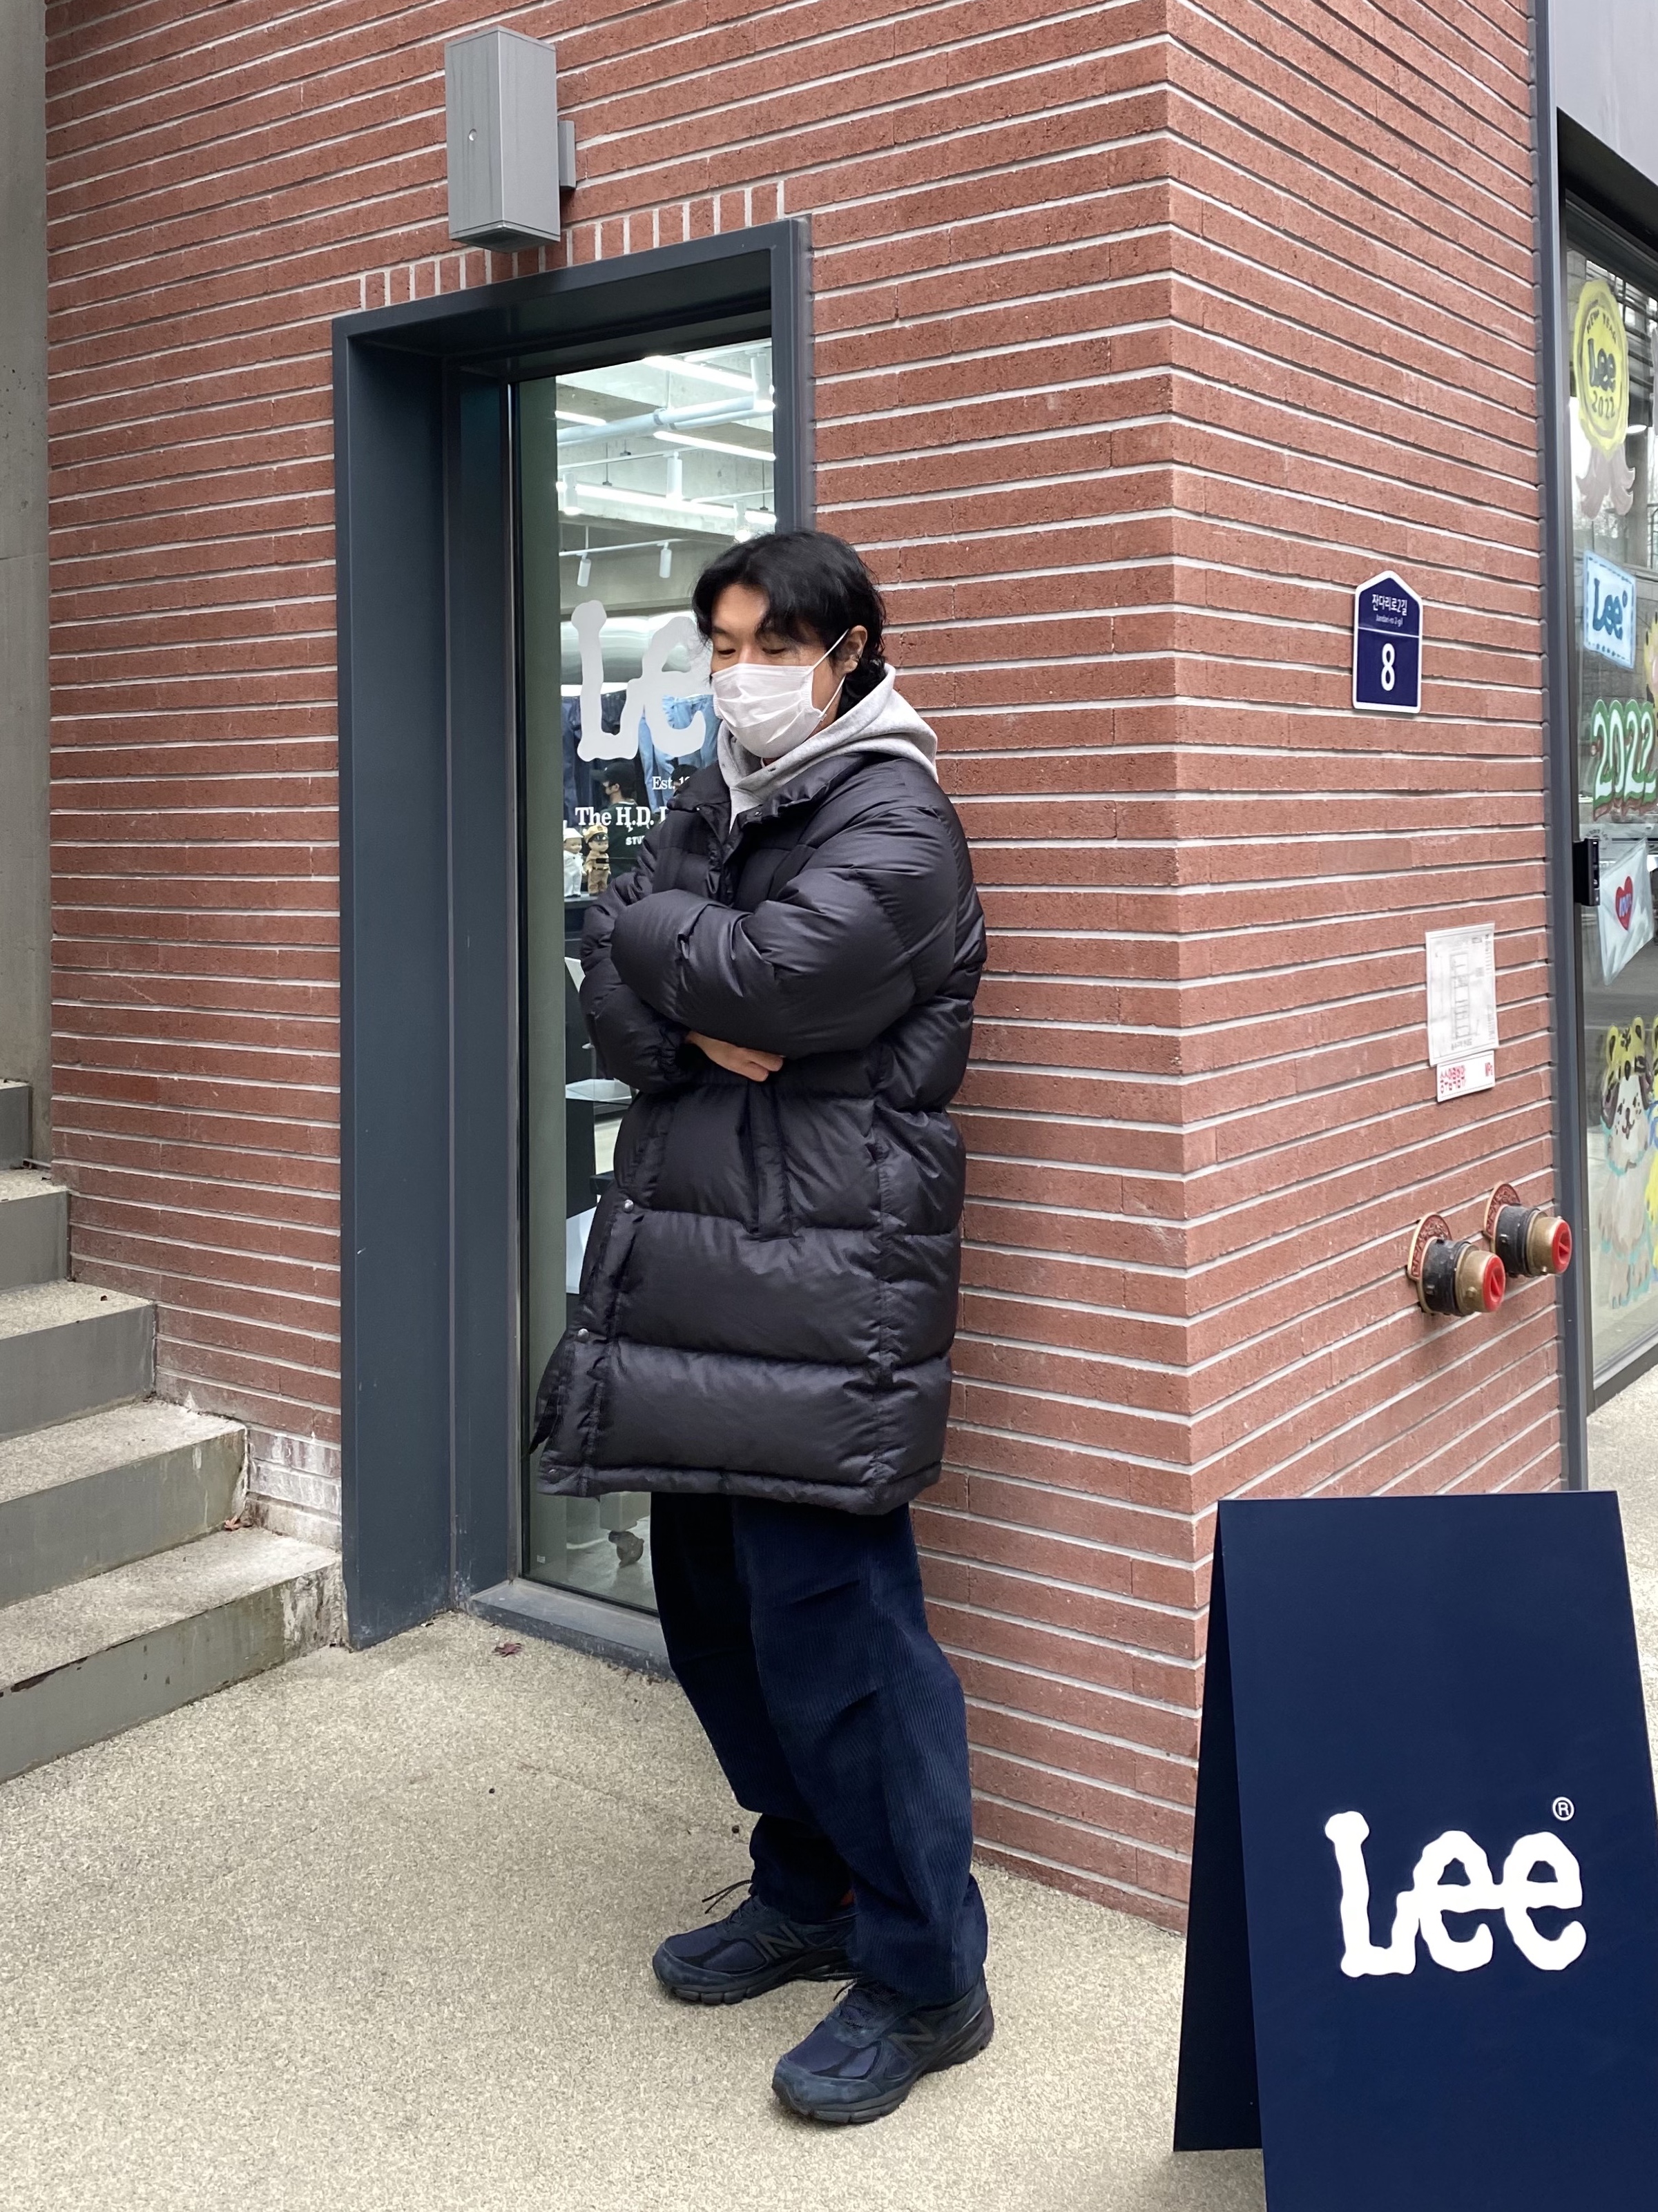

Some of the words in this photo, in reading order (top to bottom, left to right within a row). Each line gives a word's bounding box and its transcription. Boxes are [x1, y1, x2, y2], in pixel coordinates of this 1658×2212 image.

[1588, 338, 1617, 393] Lee
[1591, 390, 1616, 420] 2022
[1371, 594, 1407, 616] 잔다리로2길
[1380, 643, 1396, 691] 8
[1590, 700, 1658, 804] 2022
[652, 776, 676, 790] Est.
[575, 806, 612, 826] The
[616, 806, 655, 826] H.D.
[1324, 1810, 1587, 1978] Lee
